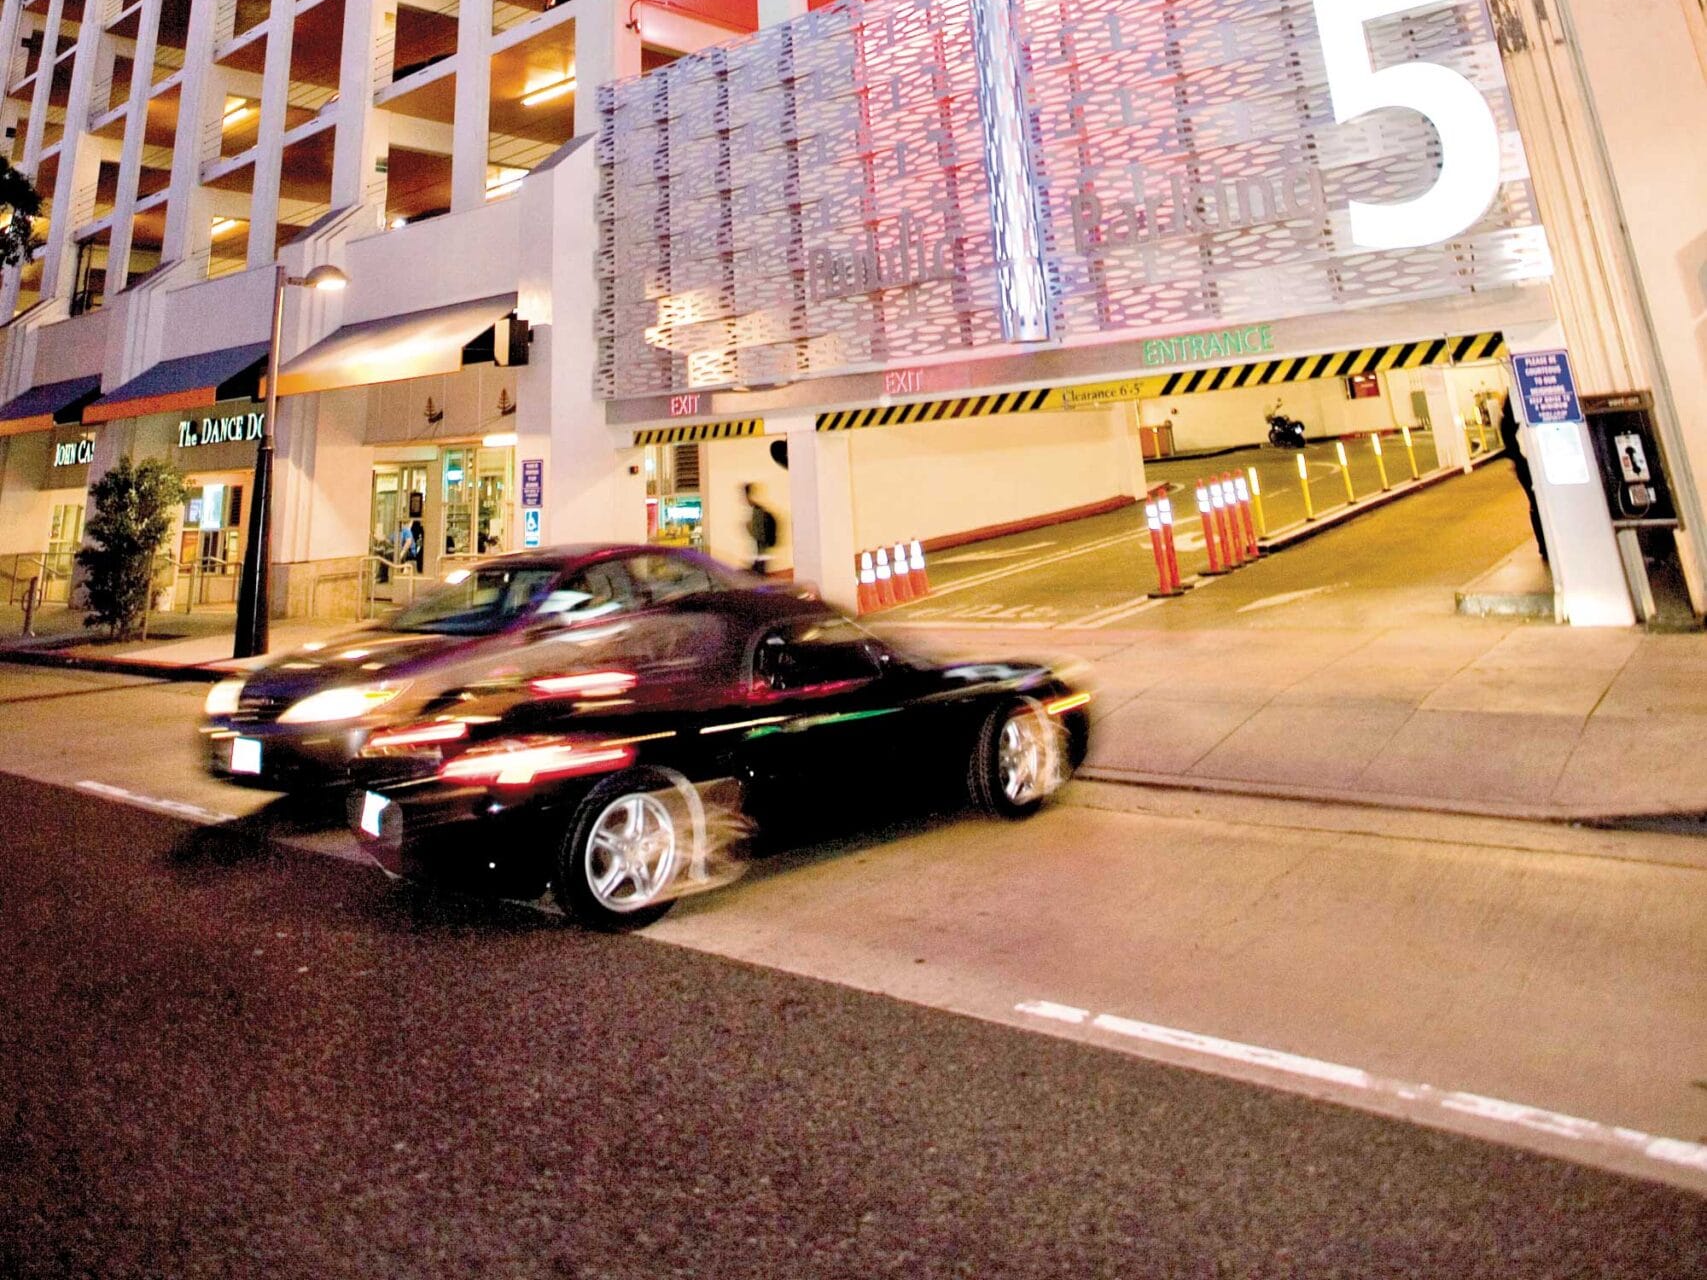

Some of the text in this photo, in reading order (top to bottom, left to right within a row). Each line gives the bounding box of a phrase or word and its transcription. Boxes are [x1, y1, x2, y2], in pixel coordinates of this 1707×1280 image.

[808, 165, 1328, 303] Public Parking
[1143, 324, 1274, 366] ENTRANCE
[885, 369, 924, 394] EXIT
[670, 394, 700, 416] EXIT
[178, 421, 198, 448] The
[201, 414, 244, 444] DANCE
[53, 442, 77, 467] JOHN
